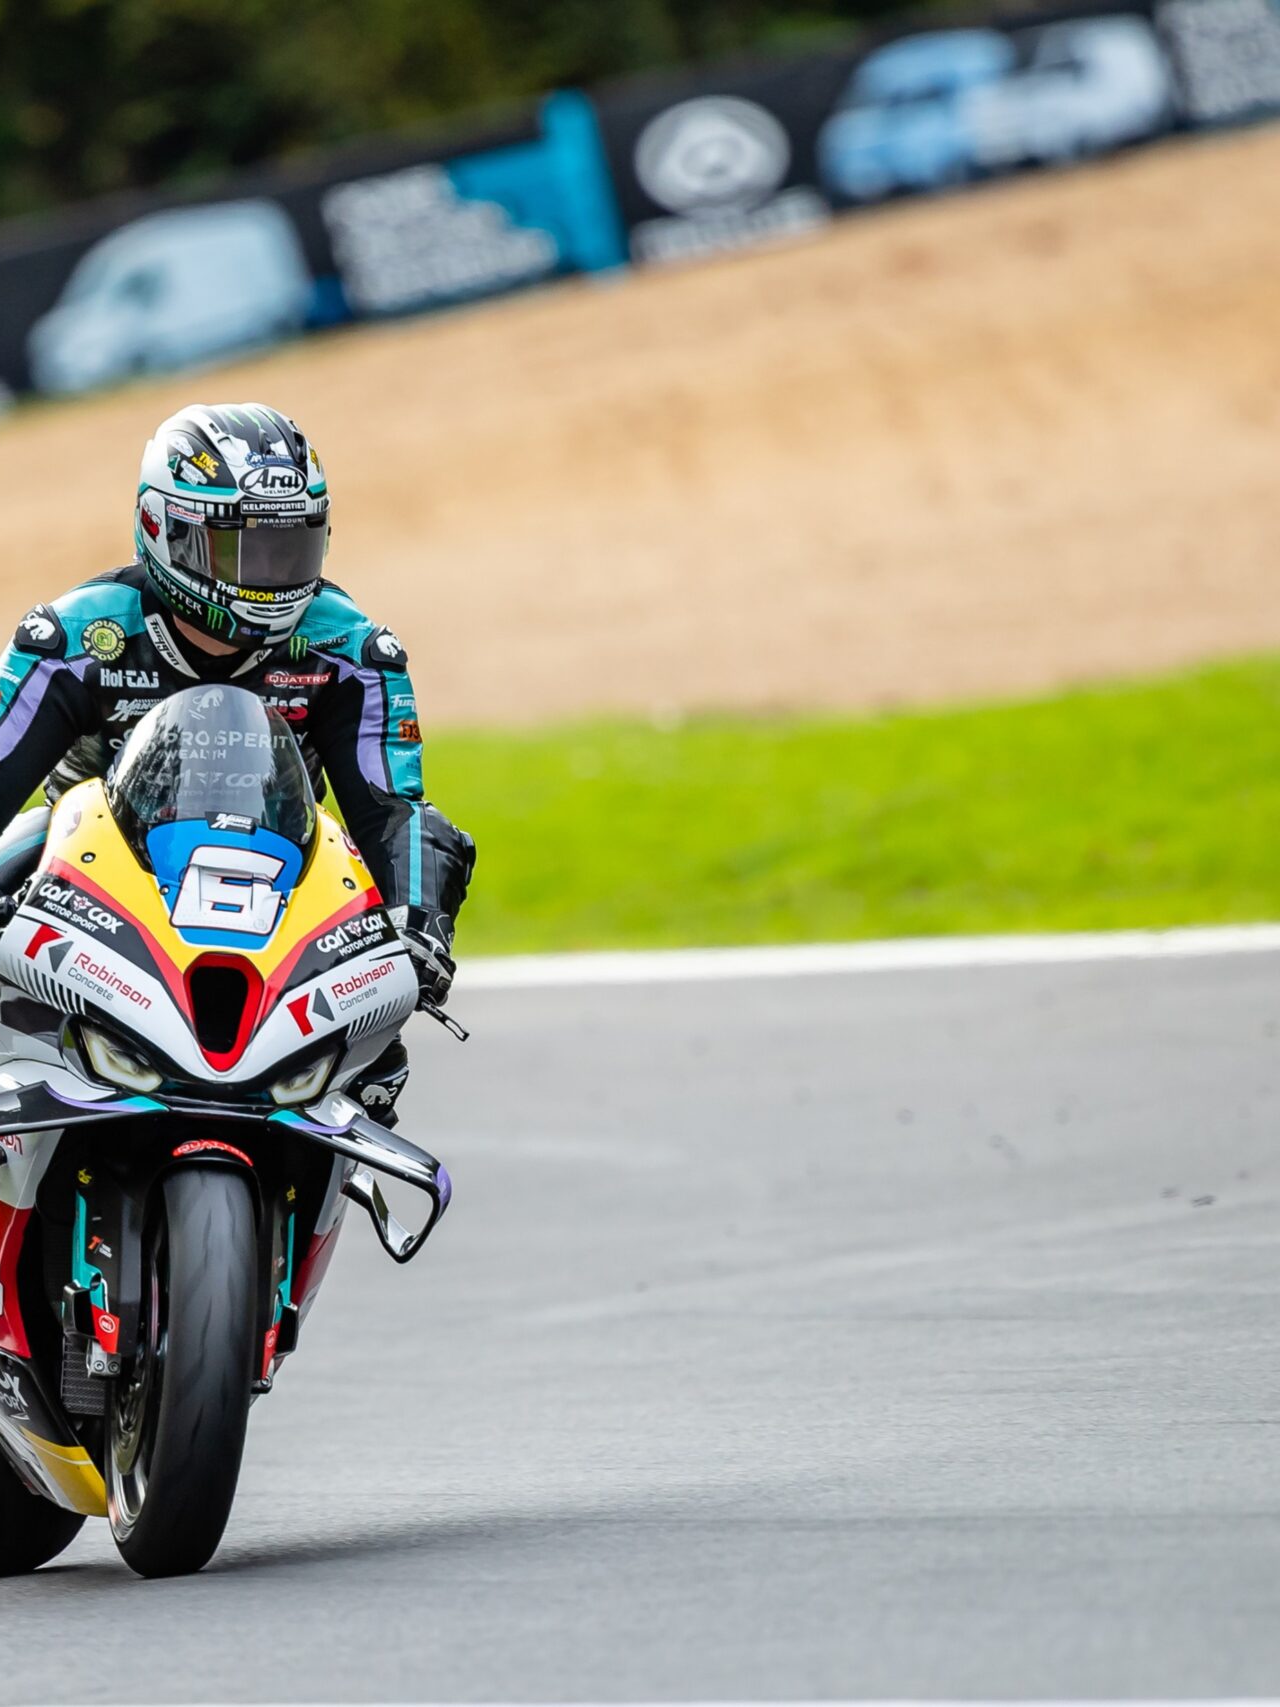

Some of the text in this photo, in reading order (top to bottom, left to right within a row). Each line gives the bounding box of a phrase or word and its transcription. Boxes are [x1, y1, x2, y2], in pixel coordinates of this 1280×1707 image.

[199, 451, 220, 472] TNC
[244, 467, 300, 490] Arai
[242, 501, 306, 511] KELPROPERTIES
[83, 619, 125, 640] AROUND
[89, 640, 126, 661] POUND
[268, 673, 331, 685] QUATTRO
[170, 844, 286, 936] 6
[43, 900, 100, 933] MOTOR SPORT
[338, 932, 384, 957] MOTOR SPORT
[67, 966, 114, 1002] Concrete
[73, 952, 153, 1011] Robinson
[331, 959, 396, 1000] Robinson
[338, 985, 379, 1012] Concrete
